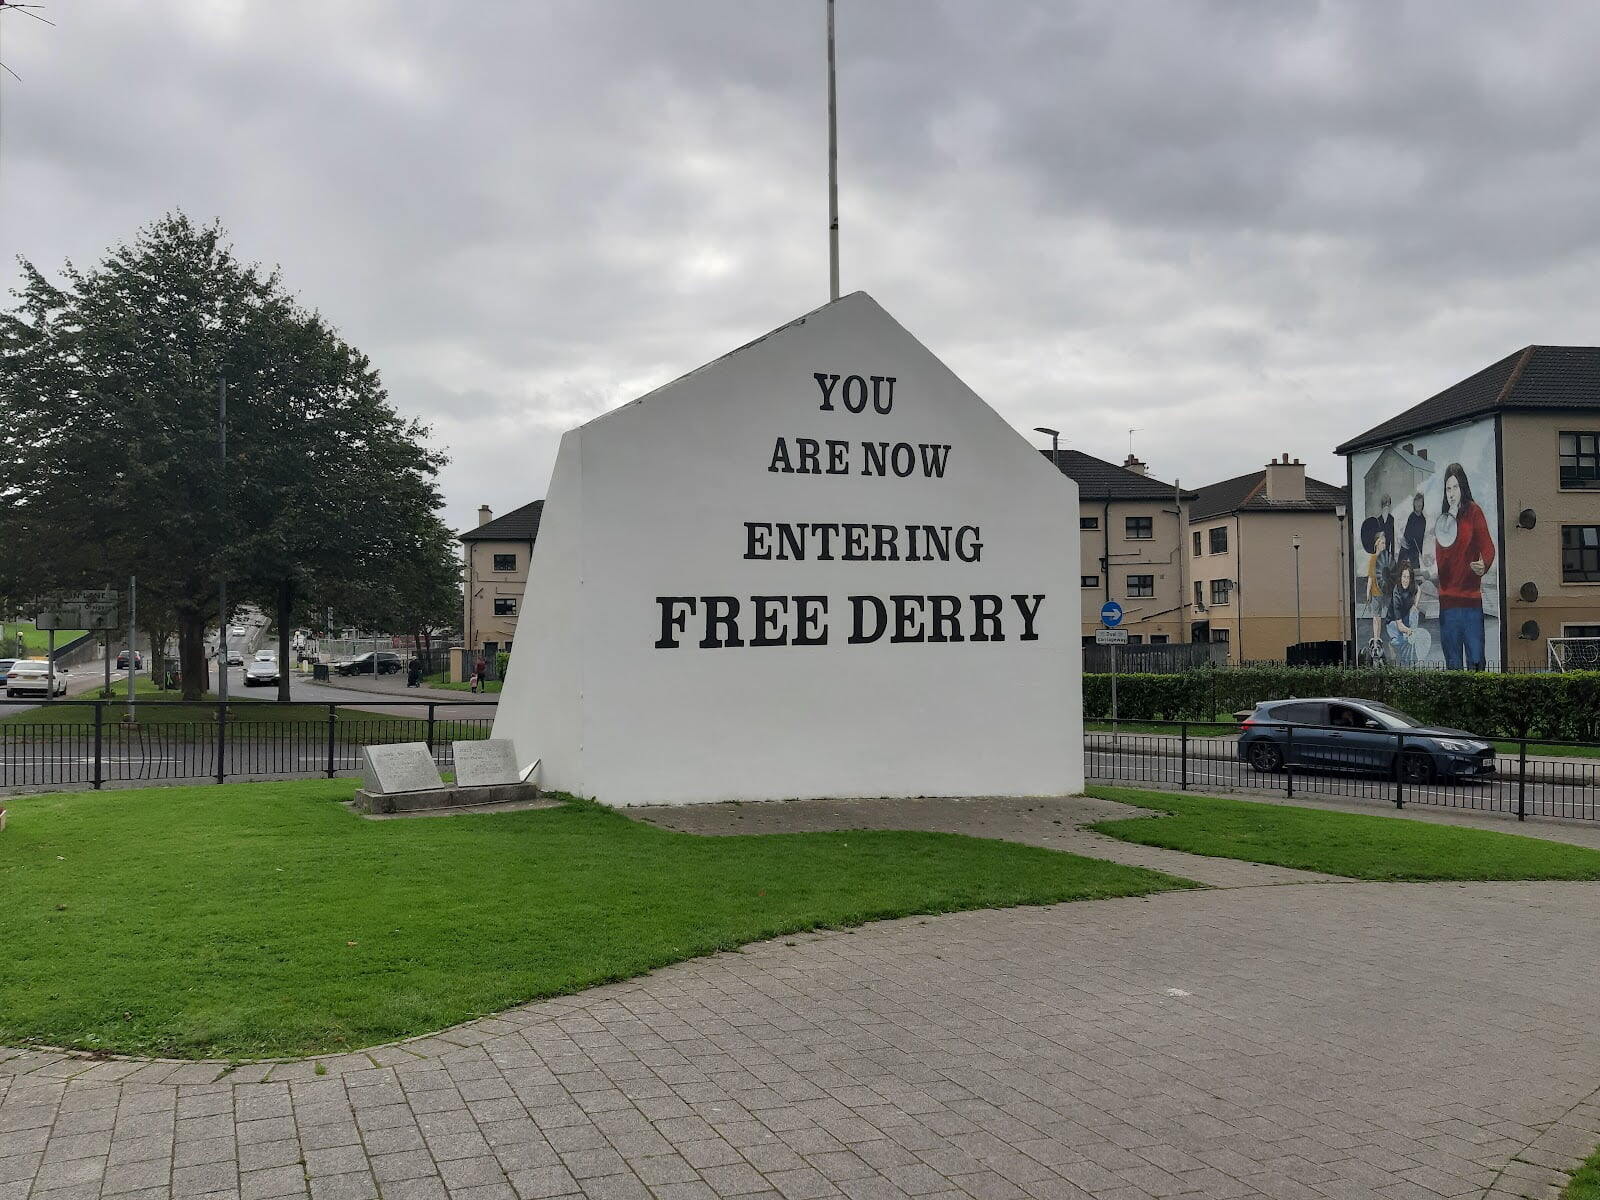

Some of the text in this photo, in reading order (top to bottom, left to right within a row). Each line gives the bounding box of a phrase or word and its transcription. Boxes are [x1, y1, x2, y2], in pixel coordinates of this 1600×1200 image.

[813, 372, 897, 415] YOU
[767, 436, 952, 479] ARE NOW
[743, 521, 984, 563] ENTERING
[654, 594, 1046, 649] FREE DERRY
